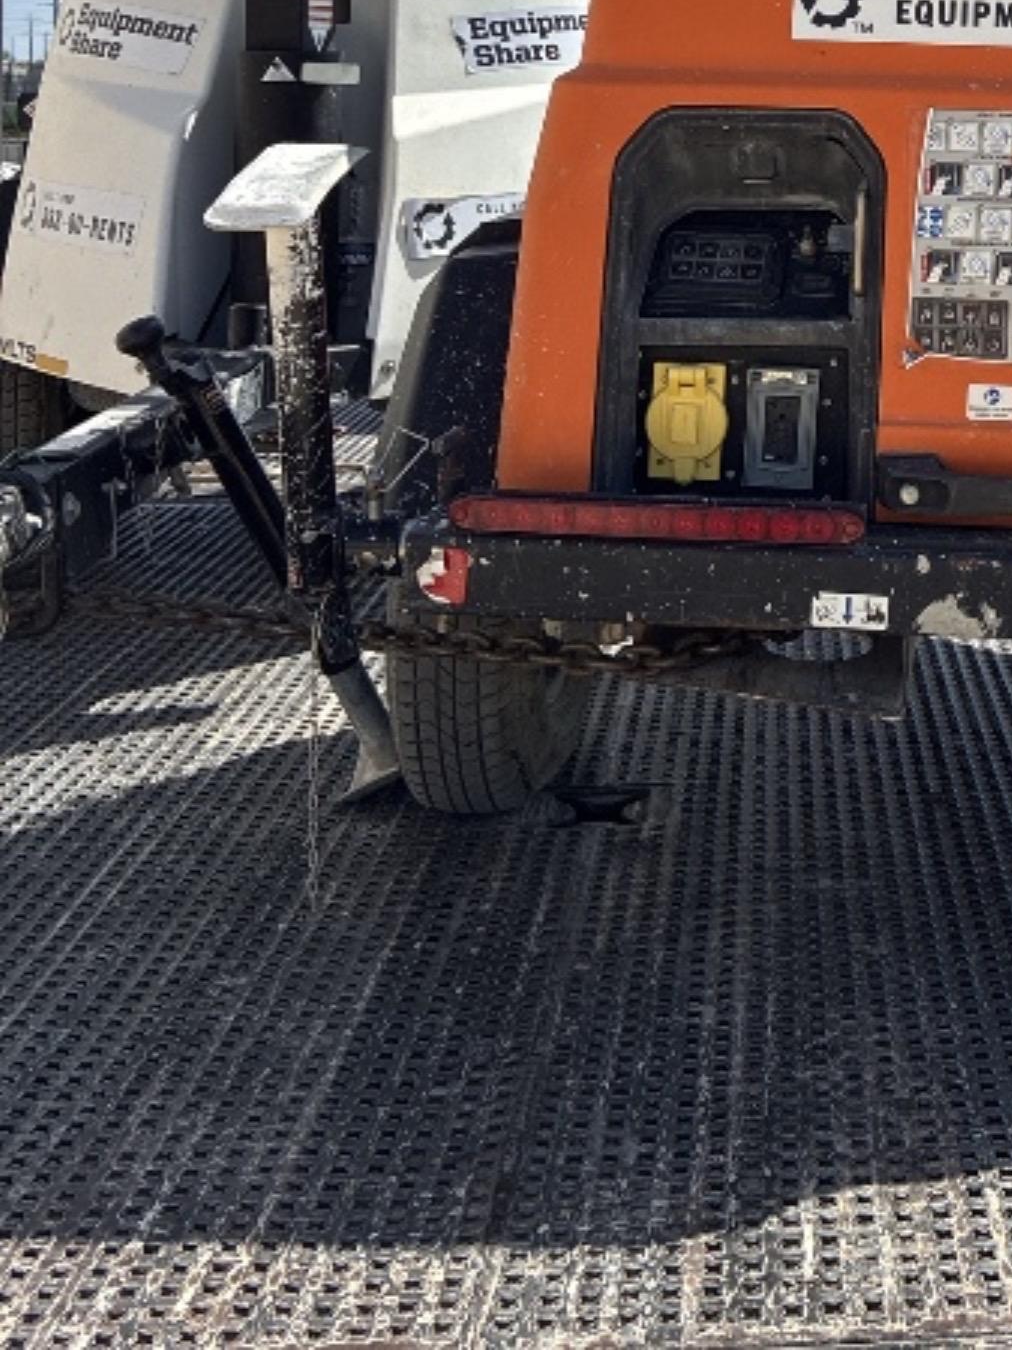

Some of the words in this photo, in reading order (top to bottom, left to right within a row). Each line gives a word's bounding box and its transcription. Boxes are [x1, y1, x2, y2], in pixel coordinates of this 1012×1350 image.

[77, 2, 198, 46] Equipment
[851, 21, 874, 34] TM
[68, 31, 123, 61] Share
[473, 43, 560, 68] Share
